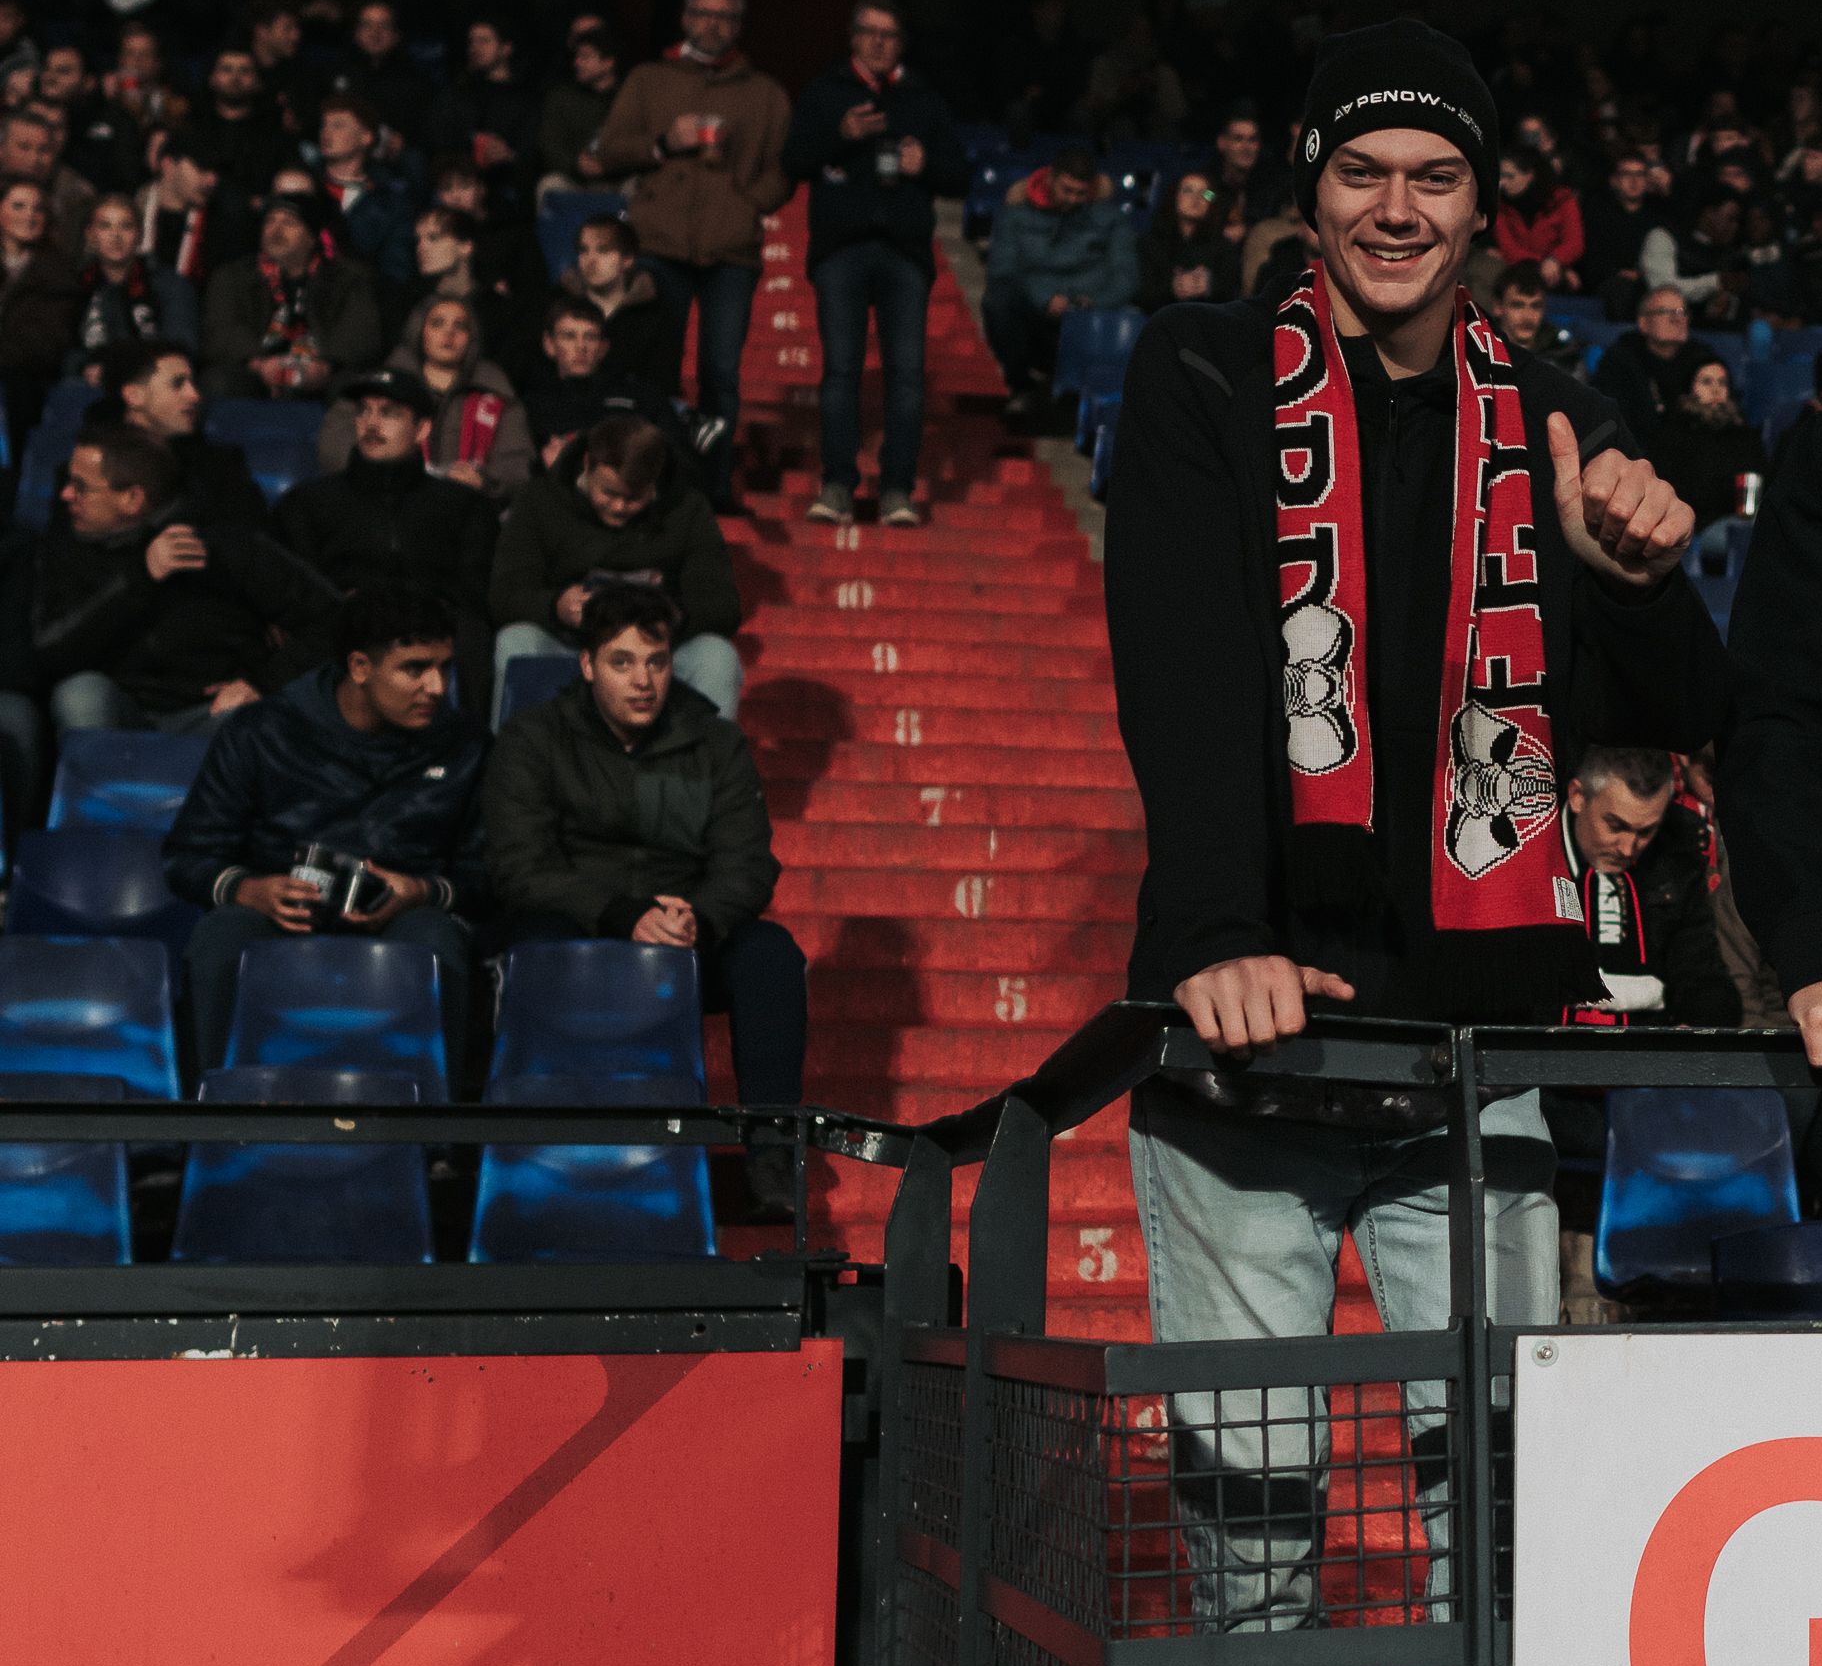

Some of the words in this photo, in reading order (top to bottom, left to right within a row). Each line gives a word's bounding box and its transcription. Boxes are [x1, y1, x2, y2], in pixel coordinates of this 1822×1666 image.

[872, 642, 898, 674] 9
[894, 709, 923, 747] 8
[918, 786, 948, 827] 7
[995, 976, 1027, 1023] 5
[1077, 1227, 1118, 1283] 3
